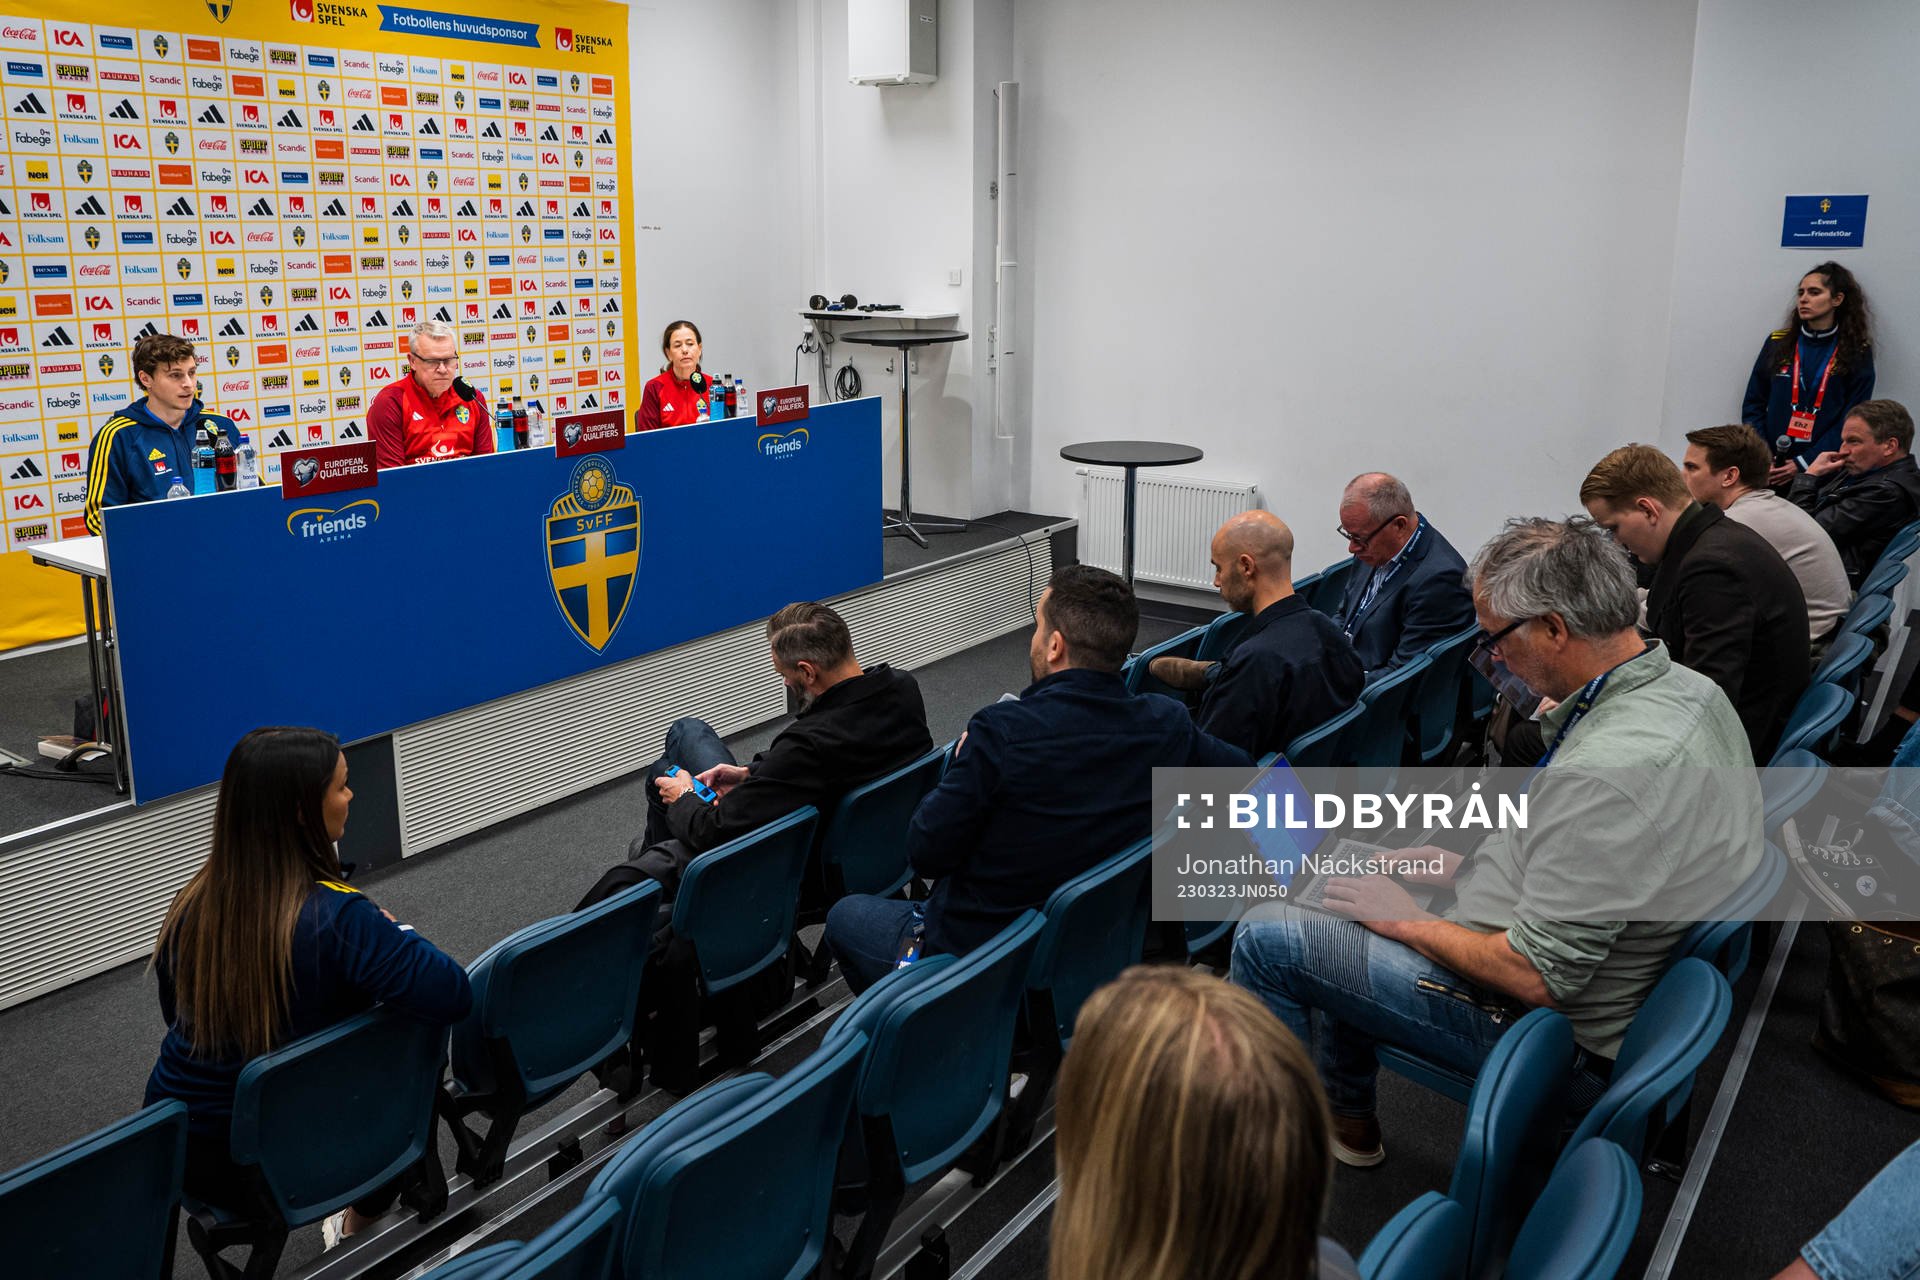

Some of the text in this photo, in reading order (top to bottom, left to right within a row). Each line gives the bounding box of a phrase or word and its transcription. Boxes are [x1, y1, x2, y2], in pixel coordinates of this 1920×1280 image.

[318, 4, 367, 18] SVENSKA
[319, 15, 344, 26] SPEL
[394, 13, 527, 40] Fotbollens huvudsponsor
[54, 30, 84, 46] ICA
[576, 35, 612, 46] SVENSKA
[576, 44, 595, 54] SPEL
[230, 49, 259, 62] Fabege
[344, 60, 370, 69] Scandic
[380, 62, 404, 75] Fabege
[413, 66, 438, 75] Folksam
[101, 72, 139, 81] BAUHAUS
[150, 75, 181, 85] Scandic
[509, 72, 527, 85] ICA
[193, 78, 222, 92] Fabege
[16, 132, 50, 146] Fabege
[64, 134, 98, 144] Folksam
[114, 134, 141, 149] ICA
[279, 144, 305, 152] Scandic
[482, 151, 503, 163] Fabege
[542, 153, 559, 164] ICA
[202, 172, 231, 184] Fabege
[245, 170, 269, 184] ICA
[390, 174, 410, 186] ICA
[597, 181, 615, 192] Fabege
[28, 234, 64, 243] Folksam
[167, 234, 197, 245] Fabege
[210, 231, 235, 244] ICA
[458, 230, 476, 241] ICA
[572, 232, 591, 241] Fabege
[600, 229, 615, 240] ICA
[426, 258, 448, 269] Fabege
[124, 265, 157, 274] Folksam
[251, 264, 278, 275] Fabege
[520, 280, 537, 291] ICA
[330, 287, 350, 299] ICA
[363, 288, 386, 299] Fabege
[86, 296, 113, 310] ICA
[127, 297, 160, 305] Scandic
[214, 295, 242, 306] Fabege
[41, 364, 81, 373] BAUHAUS
[494, 358, 514, 368] Fabege
[370, 367, 390, 379] ICA
[605, 371, 620, 381] ICA
[47, 397, 80, 408] Fabege
[93, 394, 126, 402] Folksam
[780, 396, 802, 404] EUROPEAN
[300, 404, 325, 413] Fabege
[777, 402, 804, 412] QUALIFIERS
[227, 409, 251, 422] ICA
[587, 424, 615, 432] EUROPEAN
[2, 434, 38, 443] Folksam
[583, 430, 618, 441] QUALIFIERS
[766, 438, 801, 455] friends
[325, 457, 363, 468] EUROPEAN
[320, 465, 368, 480] QUALIFIERS
[14, 494, 44, 510] ICA
[301, 513, 366, 537] friends
[577, 513, 613, 531] SvFF
[320, 534, 352, 543] ARENA
